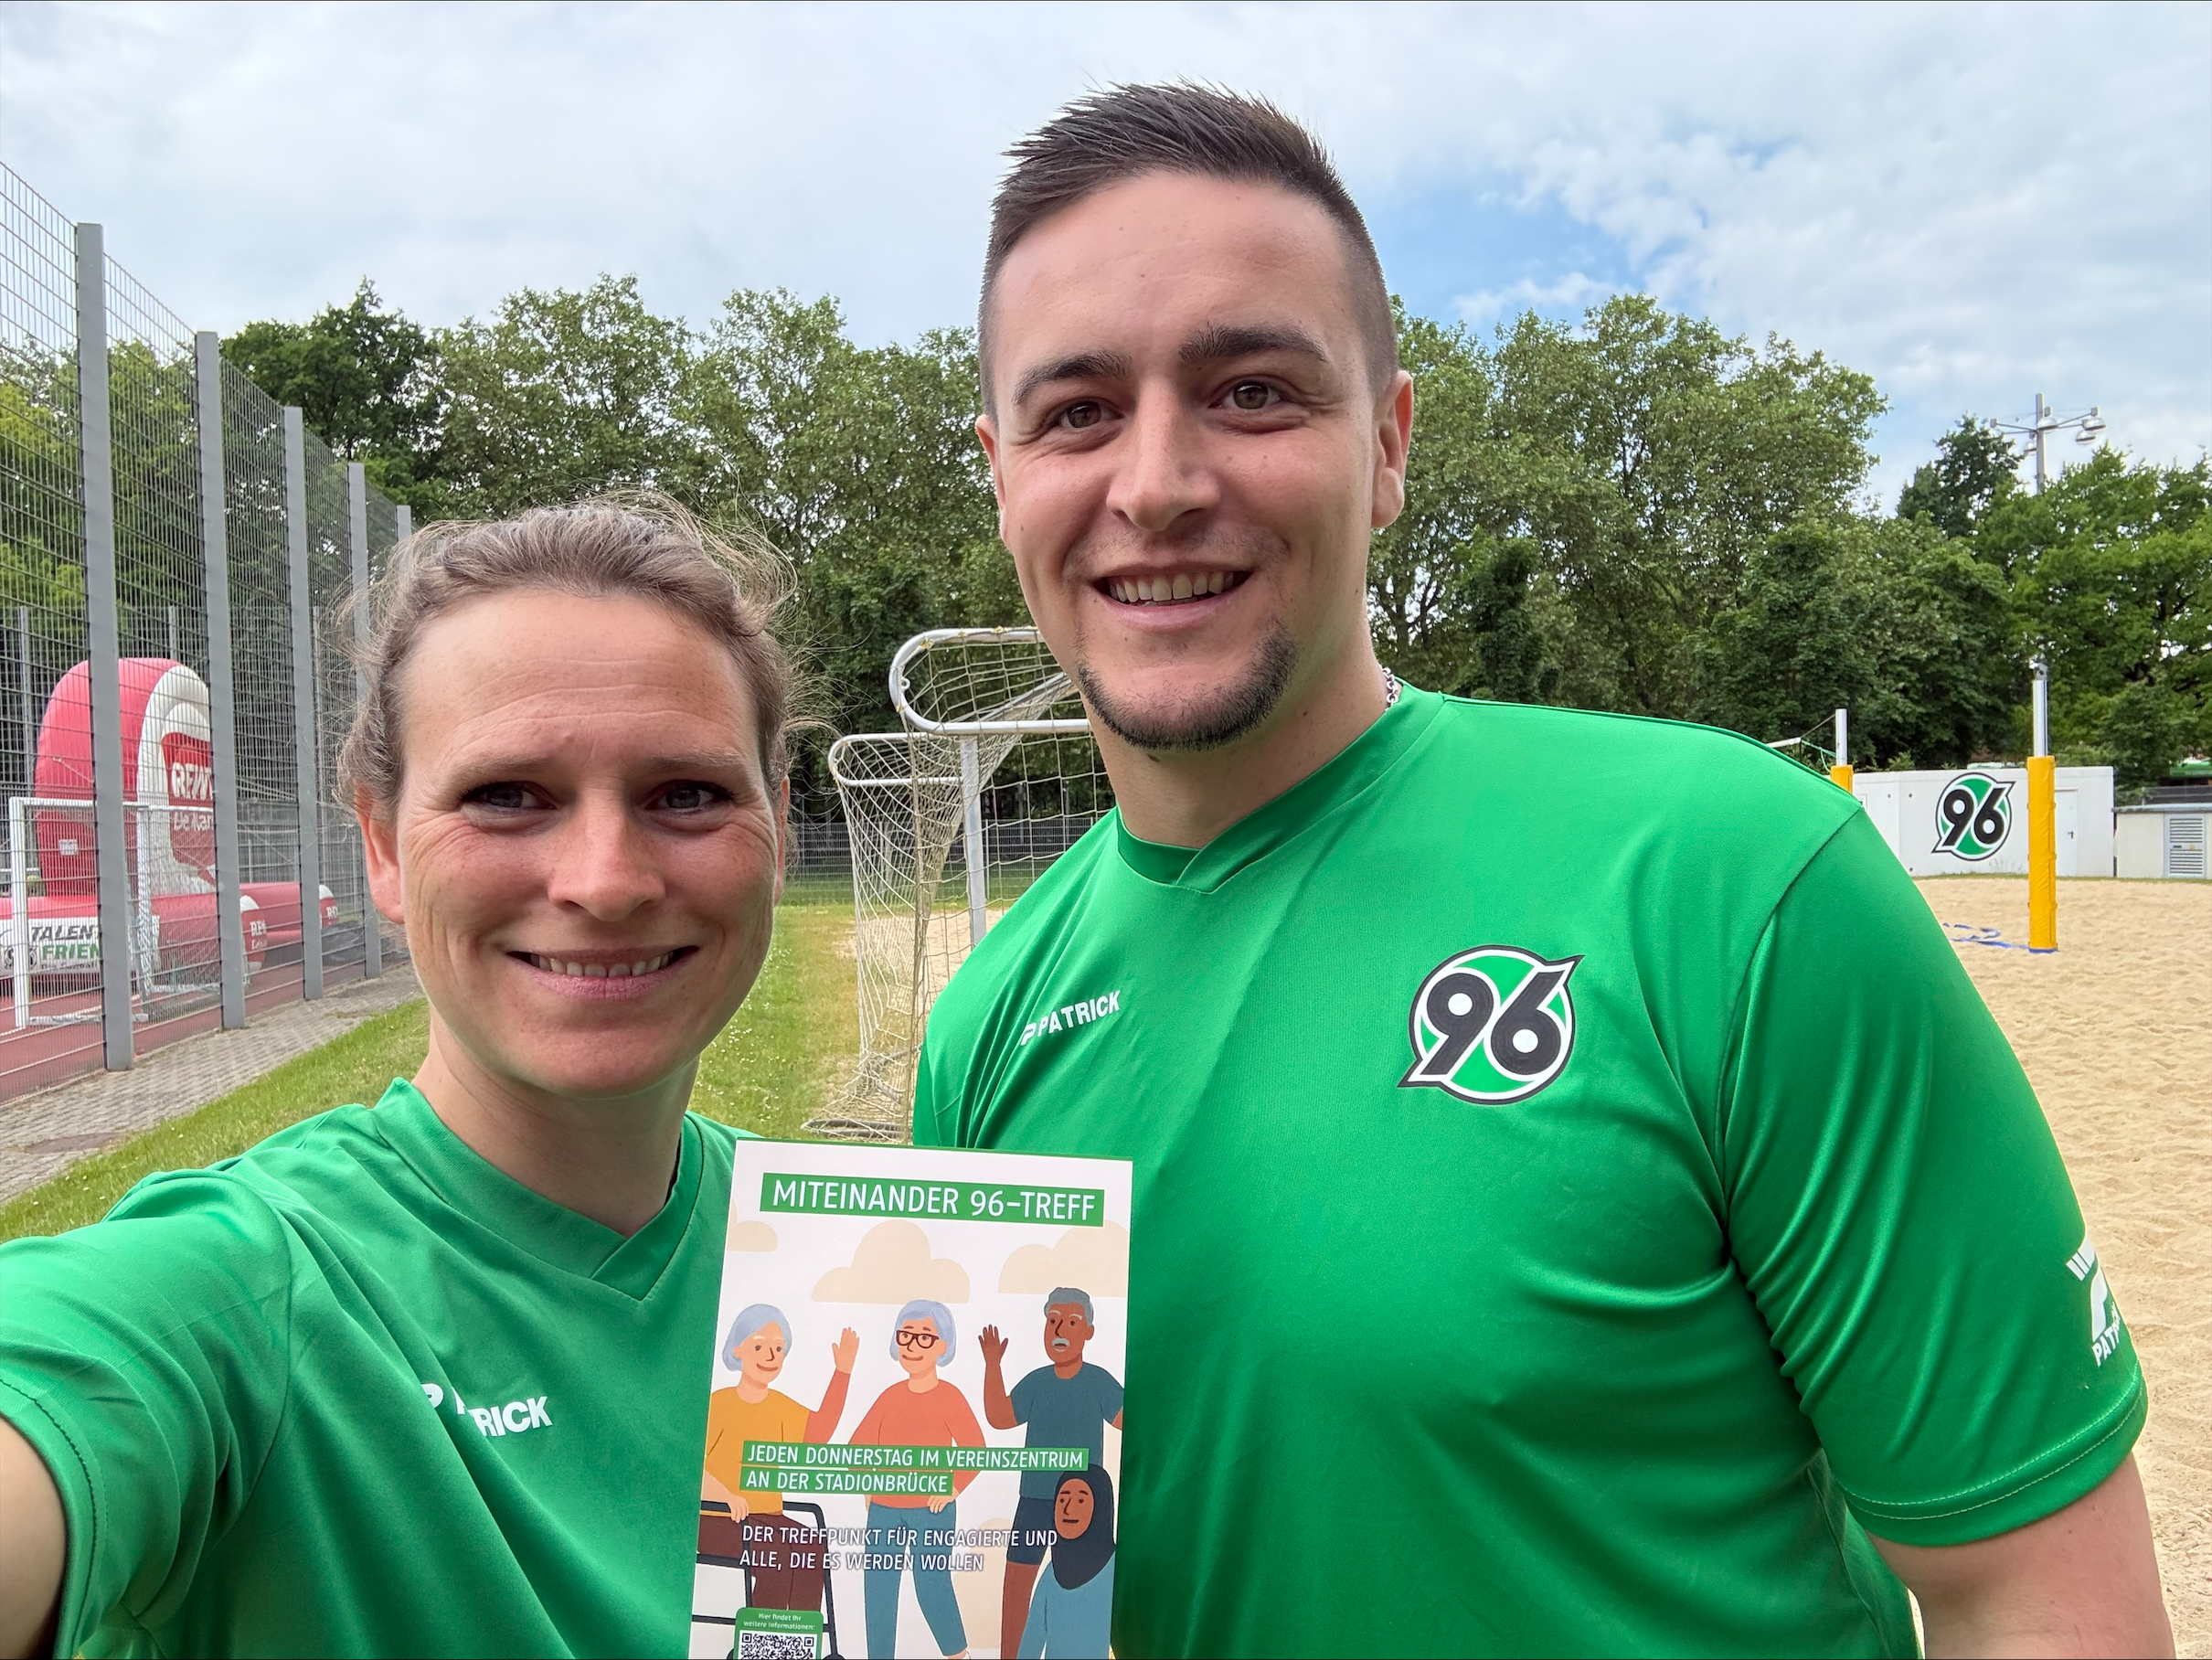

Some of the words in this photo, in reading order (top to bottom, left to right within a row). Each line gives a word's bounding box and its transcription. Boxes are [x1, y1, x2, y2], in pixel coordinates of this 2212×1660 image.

[1941, 784, 2009, 850] 96
[31, 924, 100, 942] TALEN
[1037, 990, 1121, 1037] PATRICK
[1415, 964, 1573, 1081] 96
[772, 1179, 958, 1215] MITEINANDER
[969, 1189, 1096, 1221] 96-TREFF
[748, 1444, 798, 1464] JEDEN
[805, 1447, 913, 1467] DONNERSTAG
[920, 1450, 939, 1466] IM
[945, 1450, 1083, 1469] VEREINSZENTRUM
[746, 1471, 770, 1489] AN
[777, 1473, 808, 1491] DER
[815, 1472, 948, 1493] STADIONBRÜCKE
[742, 1525, 774, 1544] DER
[780, 1526, 882, 1547] TREFFPUNKT
[887, 1527, 918, 1547] FÜR
[923, 1528, 1020, 1548] ENGAGIERTE
[1026, 1530, 1058, 1548] UND
[739, 1550, 782, 1571] ALLE,
[790, 1552, 815, 1570] DIE
[823, 1553, 840, 1570] ES
[847, 1553, 915, 1571] WERDEN
[920, 1554, 984, 1572] WOLLEN
[758, 1612, 771, 1621] Hier
[772, 1613, 792, 1622] findet
